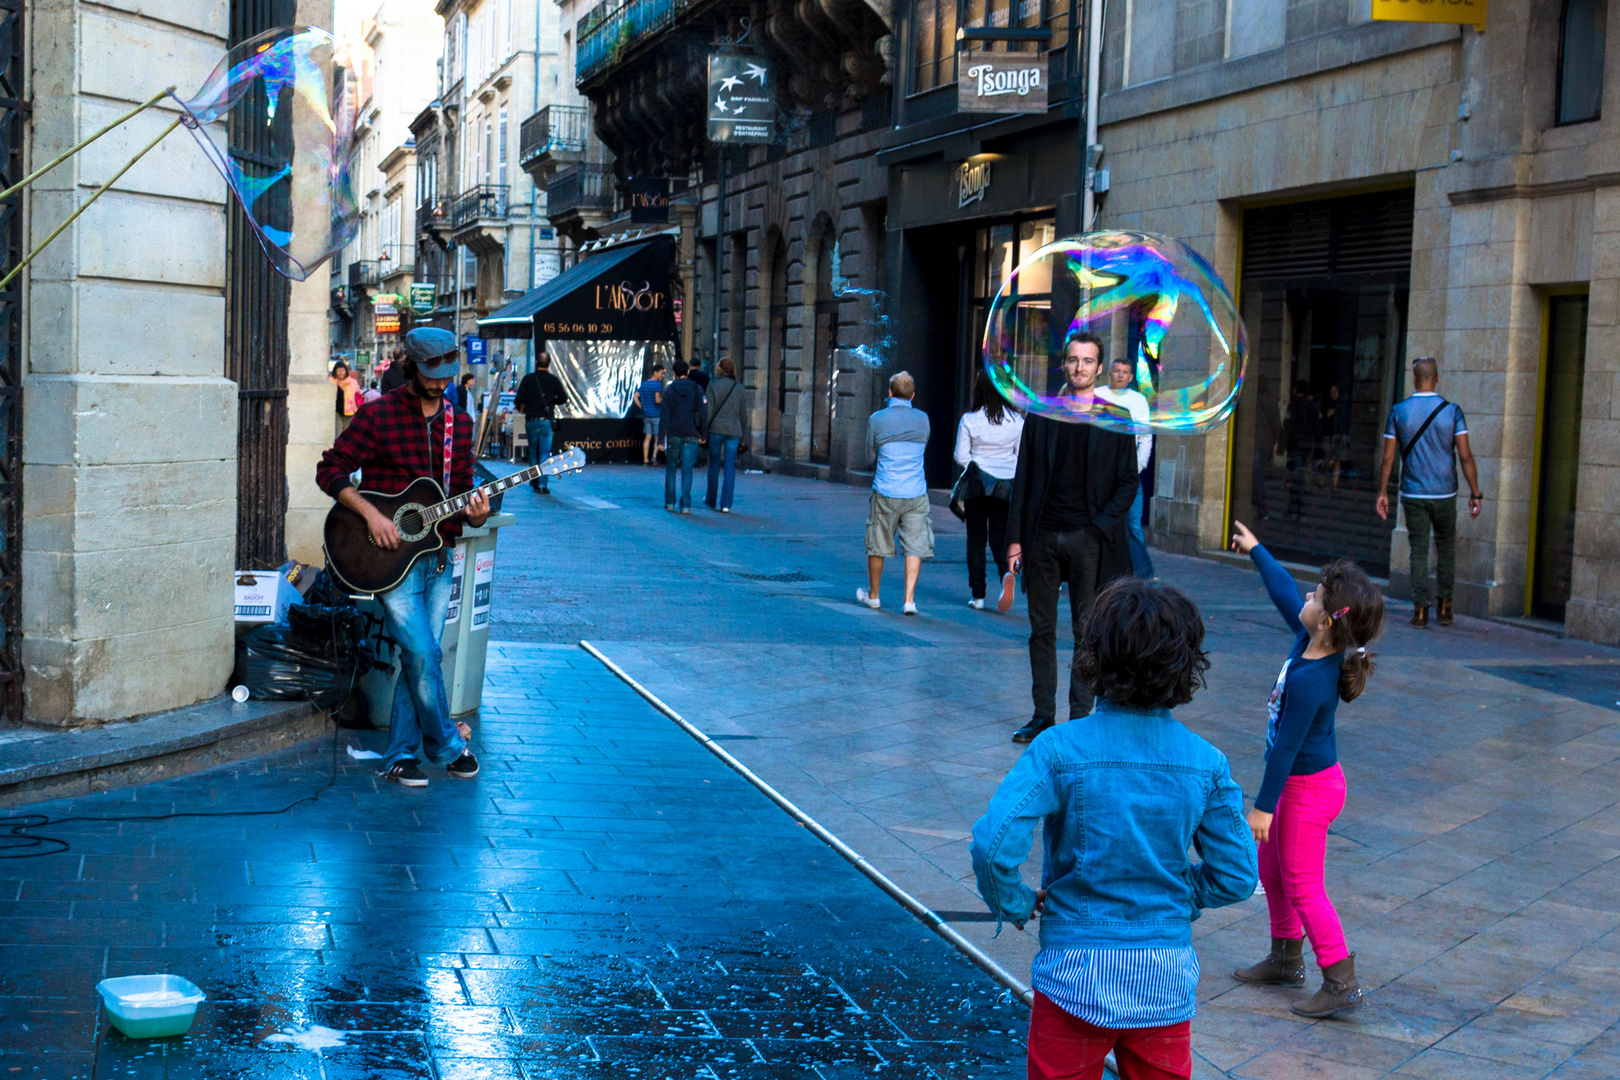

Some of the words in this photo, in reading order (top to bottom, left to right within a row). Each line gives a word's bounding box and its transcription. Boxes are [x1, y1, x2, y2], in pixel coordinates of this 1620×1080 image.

[968, 64, 1040, 97] Tsonga
[956, 161, 991, 208] Tsonga
[544, 323, 556, 334] 05
[558, 323, 570, 334] 56
[572, 323, 585, 334] 06
[588, 323, 598, 334] 10
[600, 323, 613, 334] 20
[564, 438, 602, 450] service
